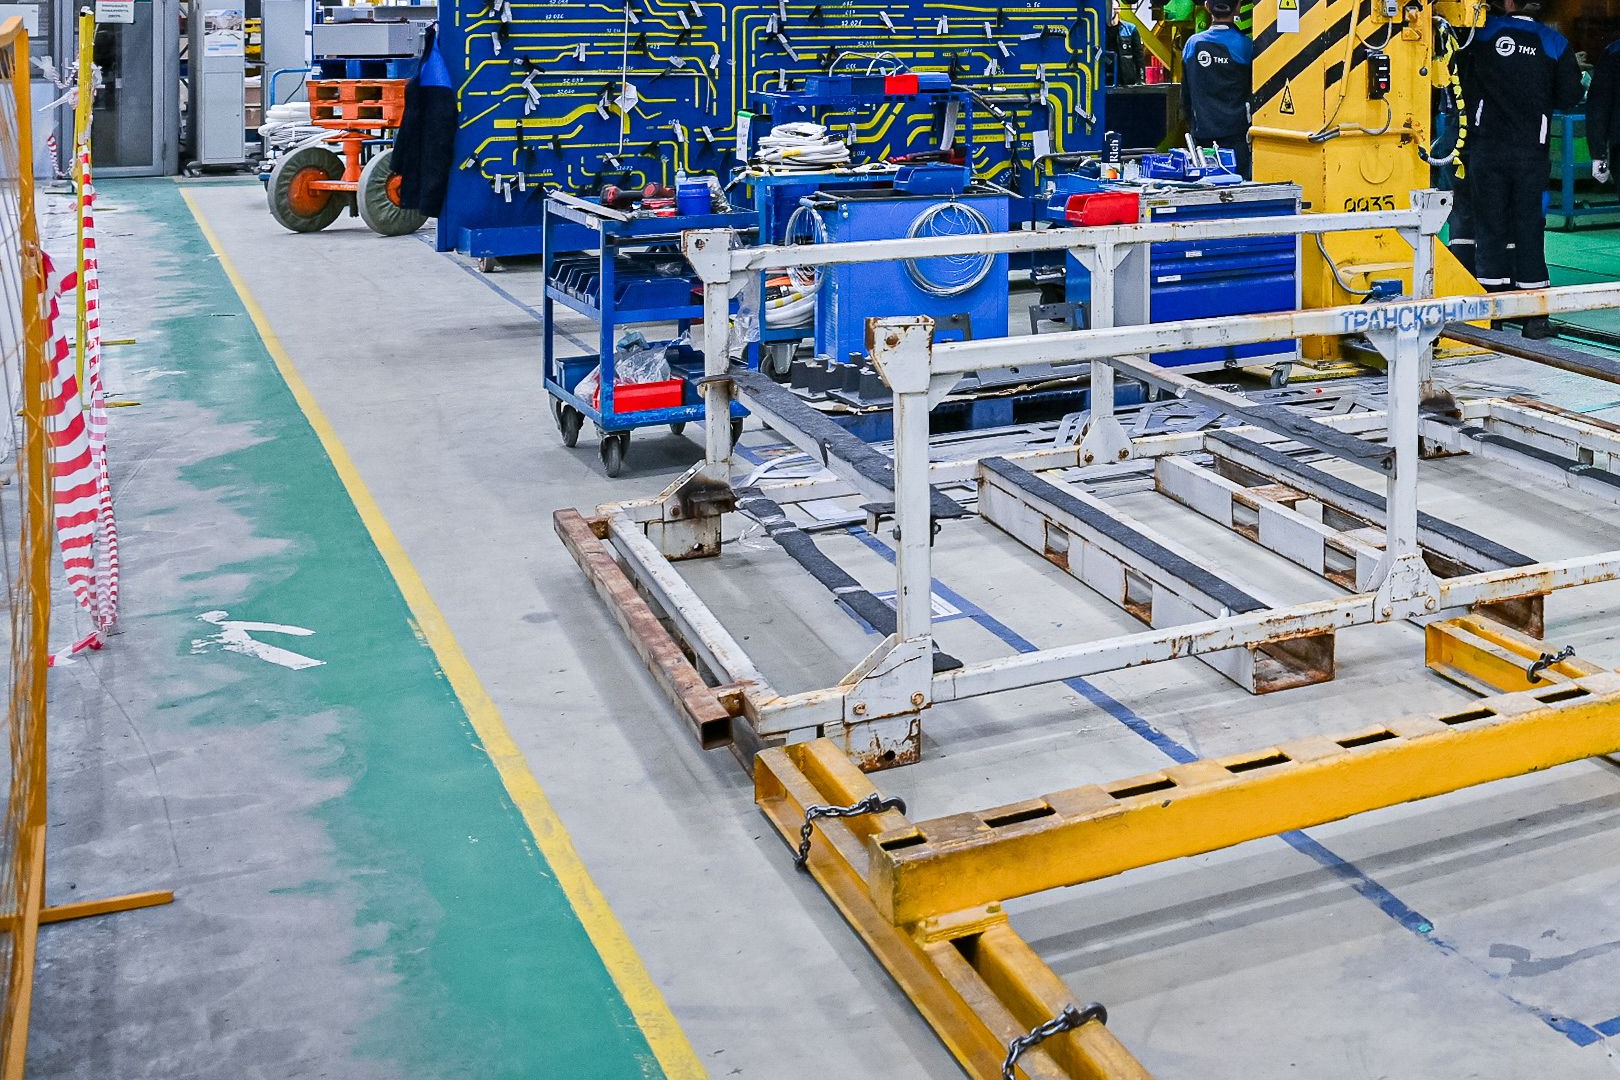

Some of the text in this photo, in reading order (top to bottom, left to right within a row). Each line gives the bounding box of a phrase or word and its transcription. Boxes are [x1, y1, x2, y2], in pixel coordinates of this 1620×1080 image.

[1518, 45, 1537, 56] ТМХ
[1213, 56, 1229, 64] ТМХ
[1109, 139, 1119, 162] Rich
[1340, 304, 1457, 332] ТРАНСКОН
